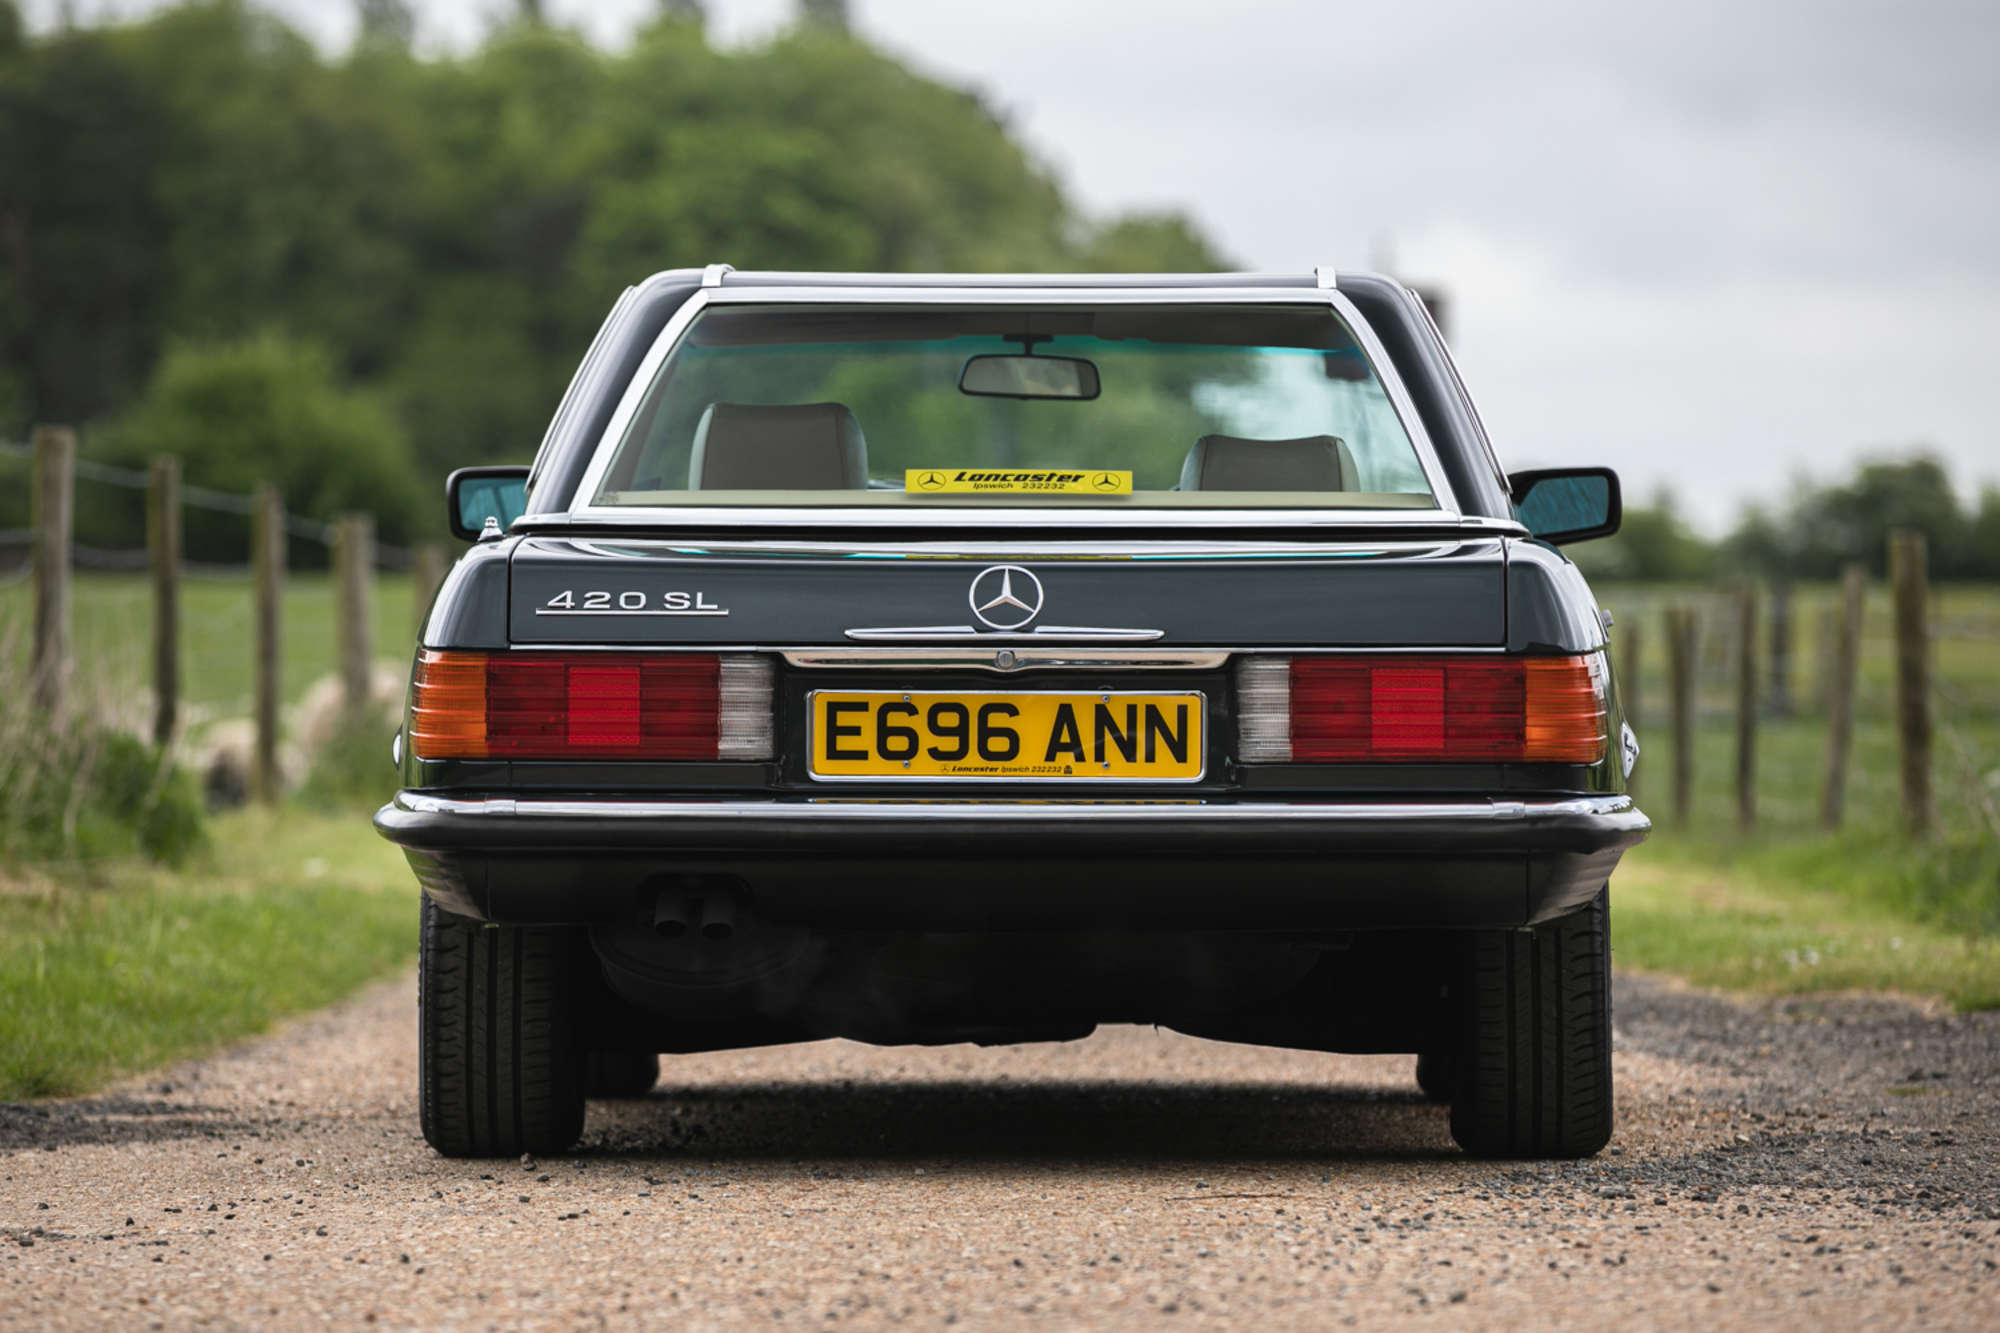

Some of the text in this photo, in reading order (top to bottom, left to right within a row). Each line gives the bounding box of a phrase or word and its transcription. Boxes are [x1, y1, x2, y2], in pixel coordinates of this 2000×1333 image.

[547, 590, 719, 610] 420 SL
[825, 701, 1188, 763] E696 ANN
[1031, 765, 1062, 773] 232232
